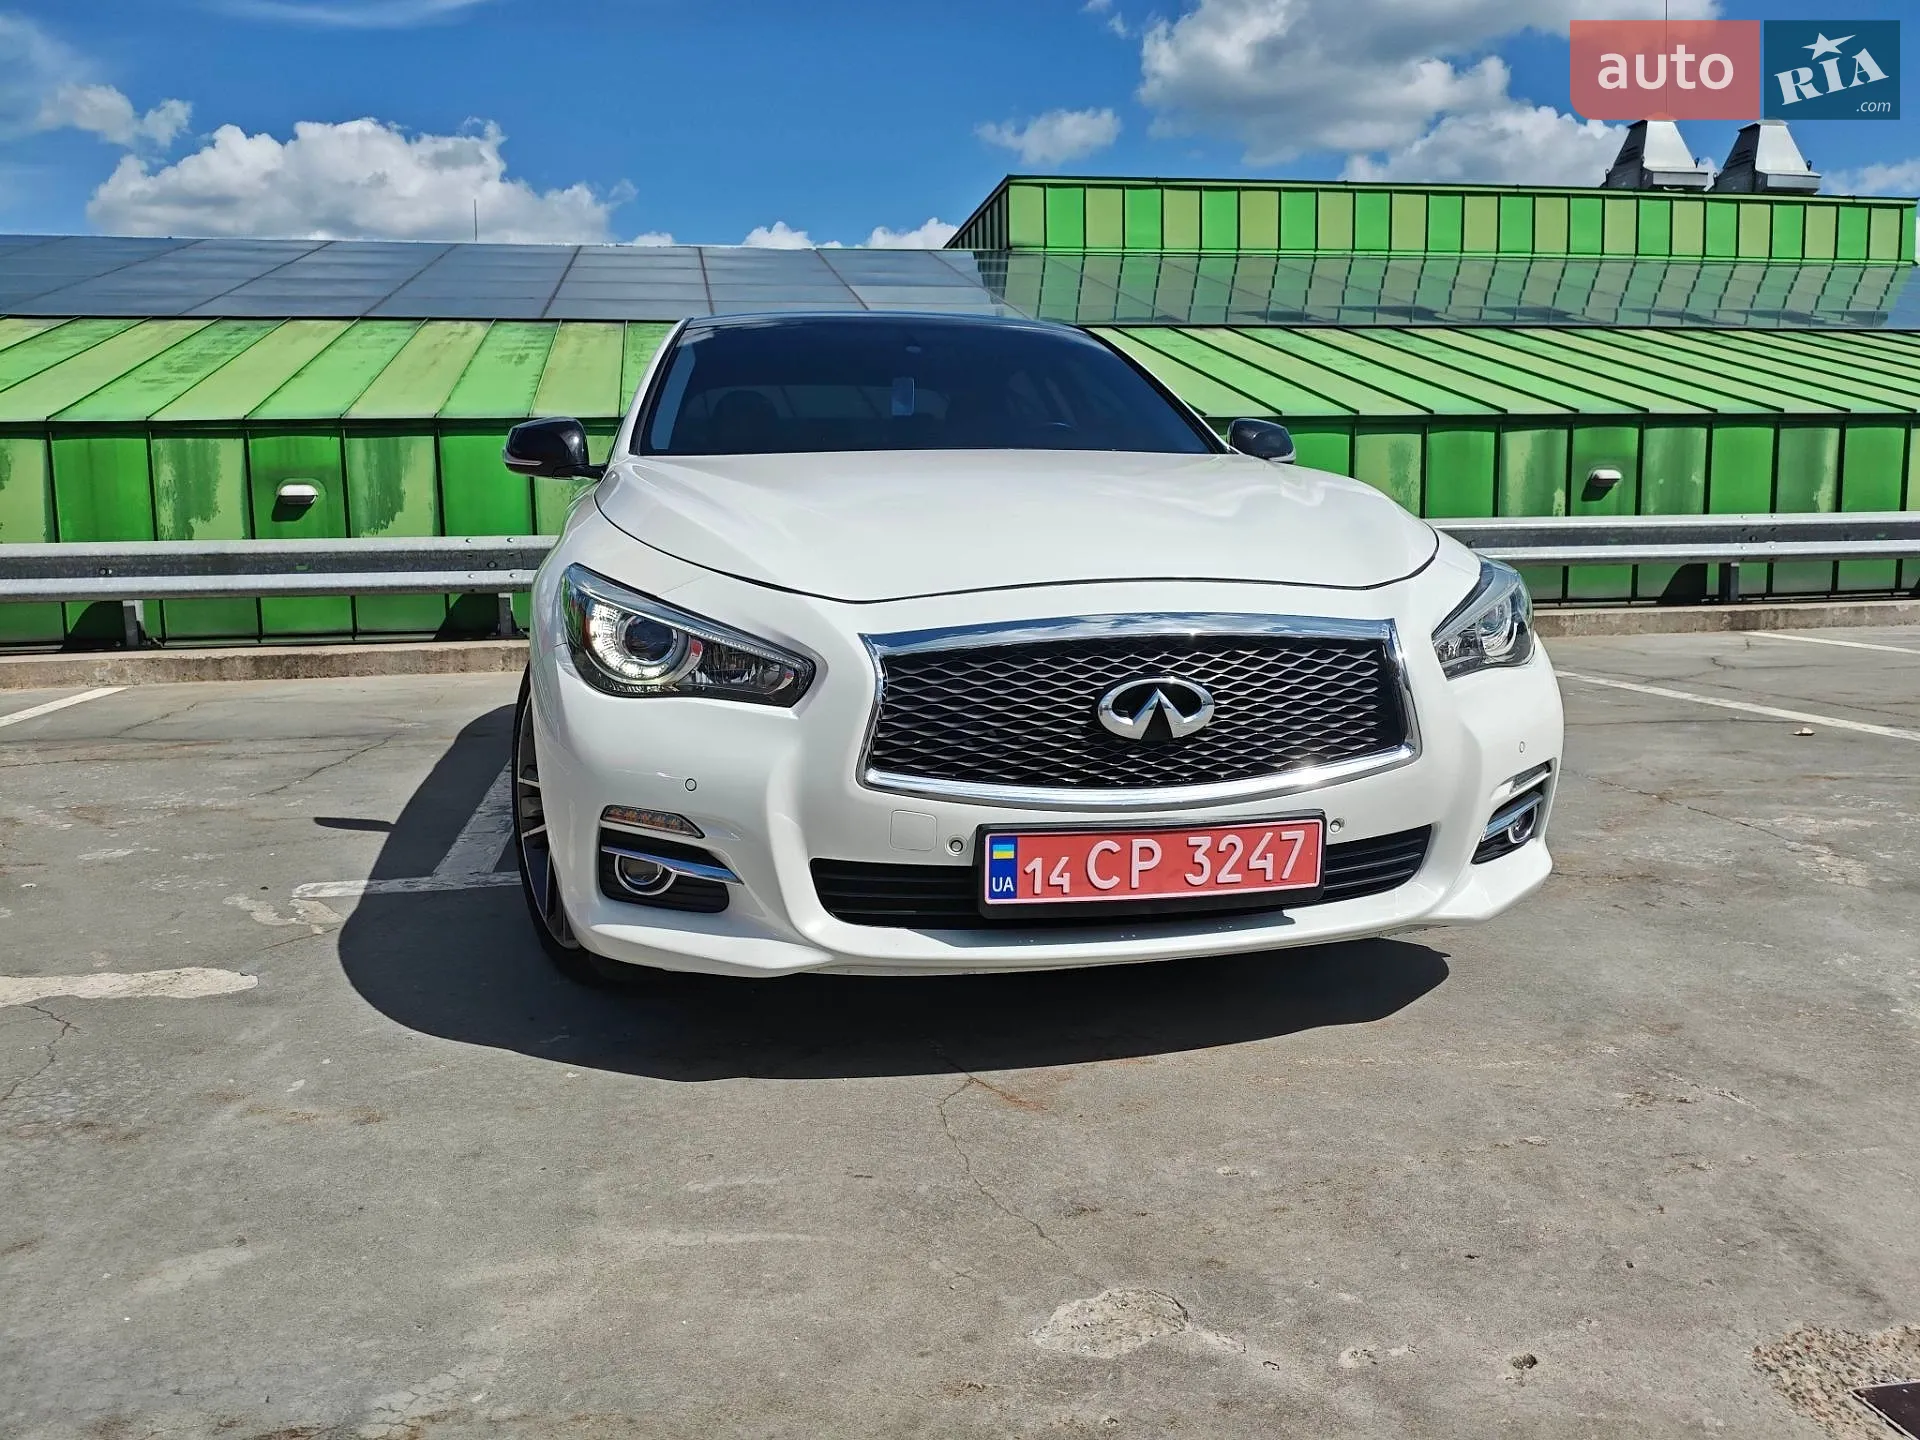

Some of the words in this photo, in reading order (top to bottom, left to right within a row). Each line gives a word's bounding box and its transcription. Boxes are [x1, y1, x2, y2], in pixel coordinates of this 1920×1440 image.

[1023, 856, 1071, 895] 14
[1085, 838, 1163, 891] CP
[1184, 830, 1306, 886] 3247
[992, 876, 1015, 893] UA
